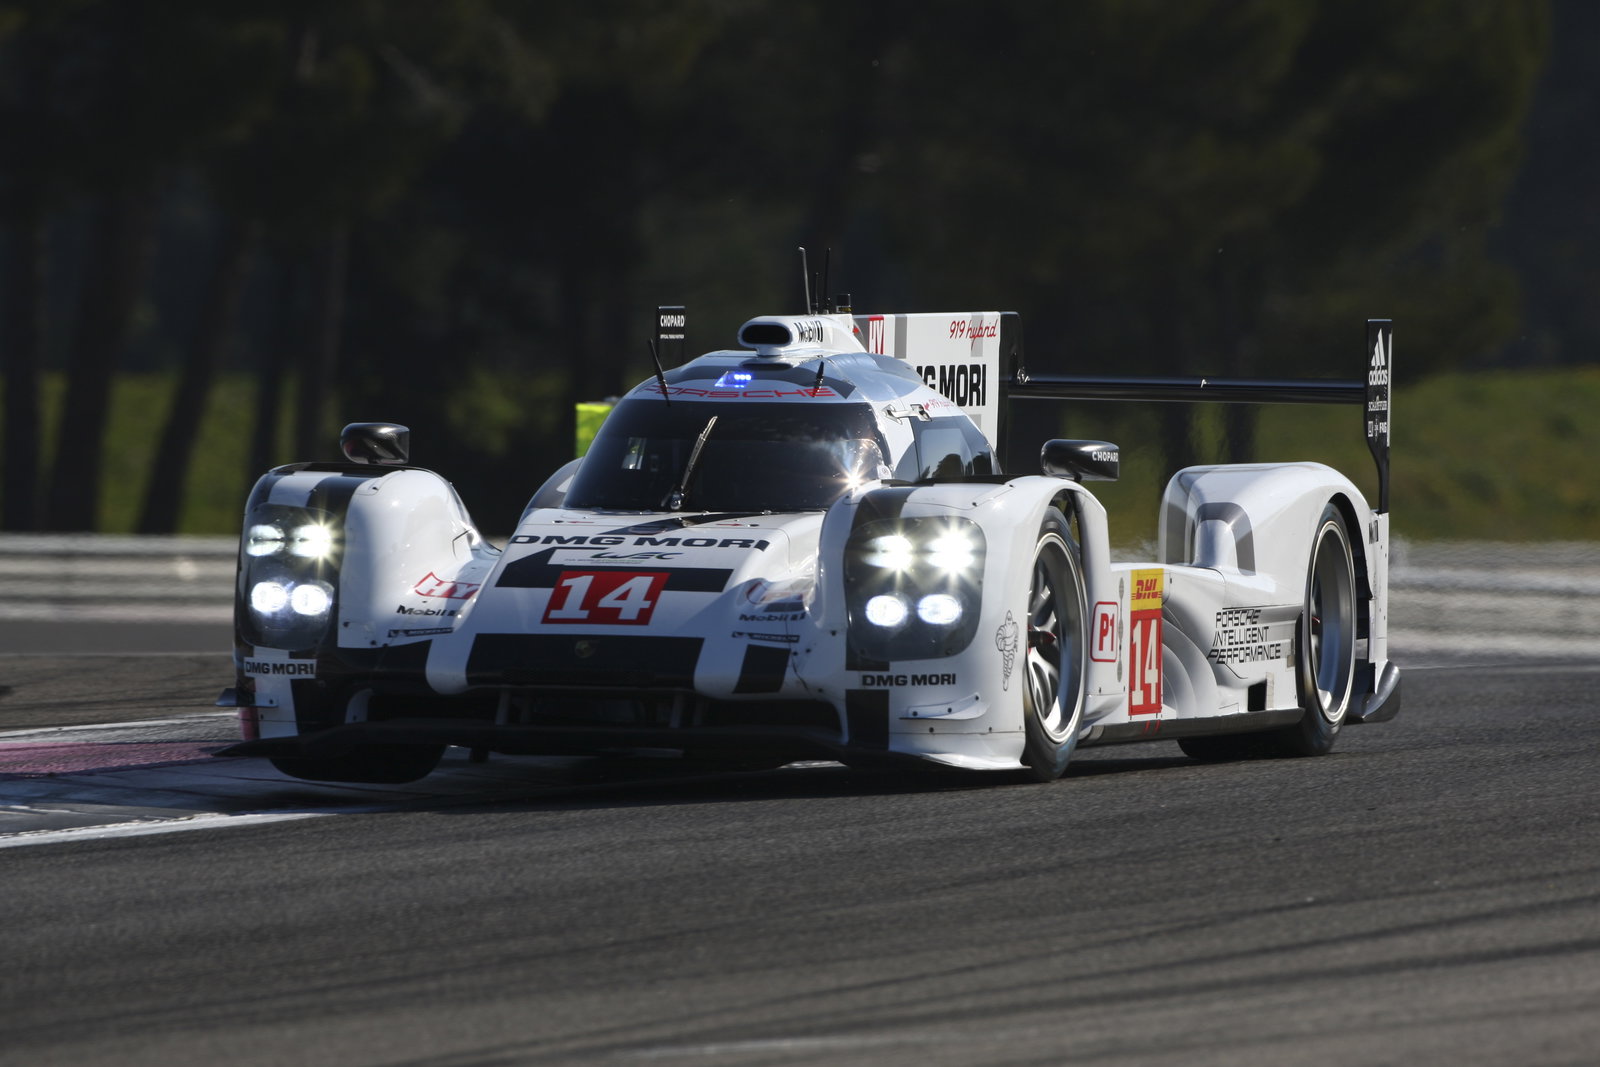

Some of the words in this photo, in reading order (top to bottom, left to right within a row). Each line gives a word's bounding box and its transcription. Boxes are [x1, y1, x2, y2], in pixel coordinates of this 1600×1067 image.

[660, 314, 685, 328] CHOPARD
[794, 320, 817, 343] Mobil
[949, 320, 966, 339] 919
[966, 318, 999, 351] hybrid
[939, 363, 987, 407] MORI
[1368, 365, 1388, 386] adidas
[1091, 451, 1119, 462] CHOPARD
[510, 535, 625, 546] DMG
[632, 536, 770, 552] MORI
[547, 575, 655, 621] 14
[1135, 577, 1159, 600] DHL
[396, 604, 448, 616] Mobil
[739, 613, 789, 622] Mobil
[1216, 609, 1262, 628] PORSCHE
[1099, 613, 1115, 652] P1
[1212, 626, 1270, 647] INTELLIGENT
[1132, 618, 1159, 706] 14
[1206, 643, 1281, 665] PERFORMANCE
[245, 661, 270, 674] DMG
[272, 662, 315, 675] MORI
[862, 674, 908, 686] DMG
[911, 673, 956, 686] MORI
